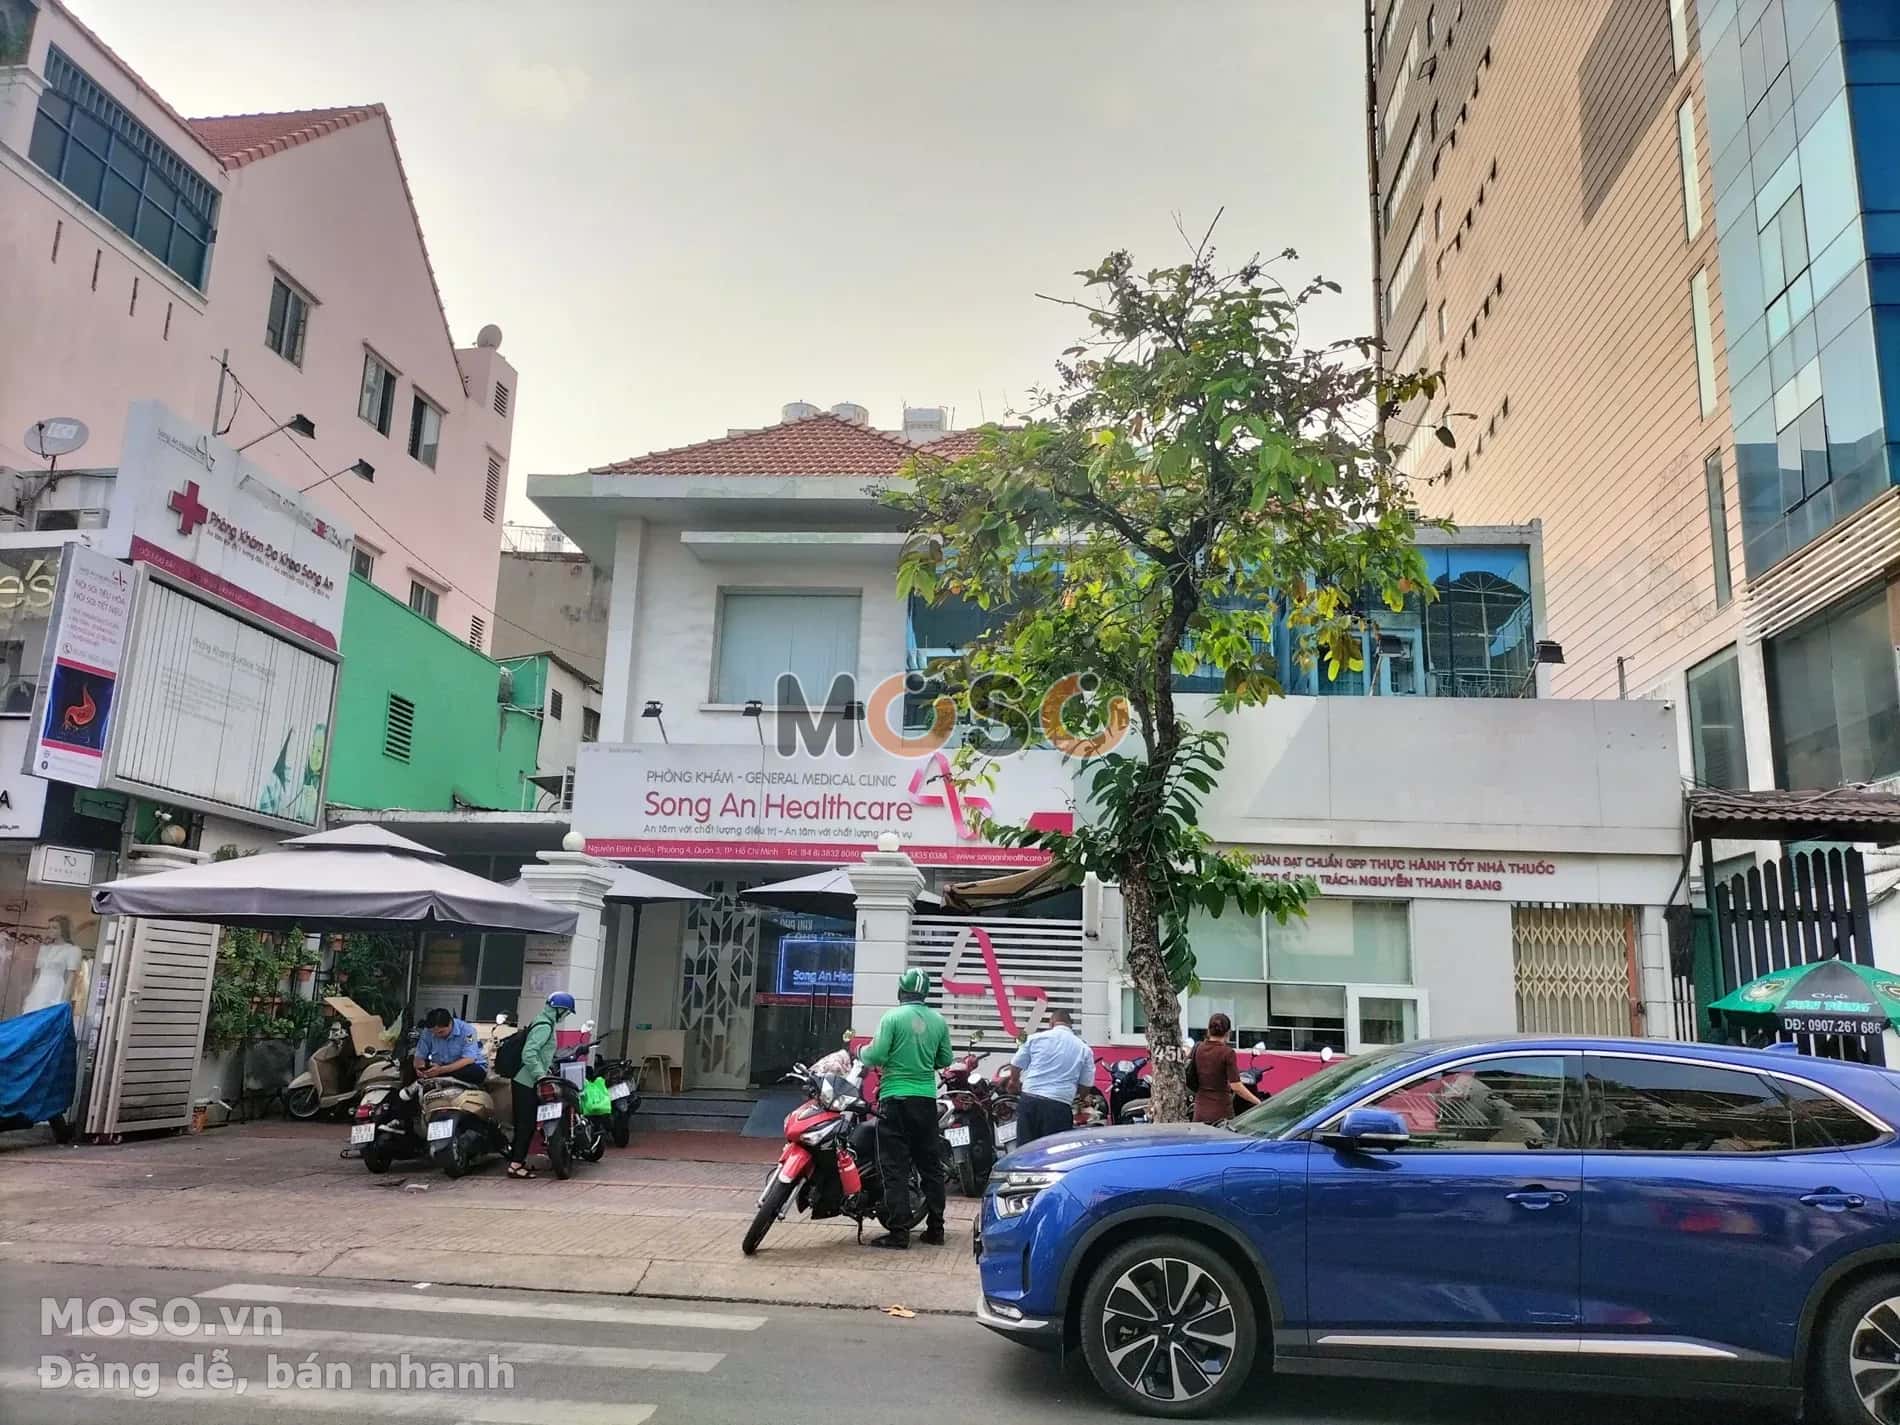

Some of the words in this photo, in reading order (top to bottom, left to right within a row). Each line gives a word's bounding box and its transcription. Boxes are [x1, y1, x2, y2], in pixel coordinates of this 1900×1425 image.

[209, 511, 237, 541] Phòng
[280, 552, 301, 574] Khoa
[301, 564, 322, 588] Song
[646, 768, 692, 784] PHÒNG
[695, 768, 734, 785] KHÁM
[745, 771, 799, 786] GENERAL
[802, 773, 856, 787] MEDICAL
[858, 774, 897, 788] CLINIC
[644, 791, 712, 824] Song
[719, 791, 756, 819] An
[765, 793, 913, 823] Healthcare
[643, 824, 657, 834] An
[658, 824, 677, 834] tâm
[784, 826, 797, 837] An
[799, 827, 816, 838] tâm
[760, 847, 779, 857] Minh
[1283, 855, 1303, 869] ĐẠT
[1305, 852, 1343, 869] CHUẨN
[1345, 858, 1367, 870] GPP
[1369, 857, 1406, 873] THỰC
[1408, 856, 1446, 873] HÀNH
[1449, 856, 1475, 873] TỐT
[1477, 858, 1506, 874] NHÀ
[1508, 859, 1556, 875] THUỐC
[1320, 872, 1358, 887] TRÁCH:
[1359, 873, 1414, 888] NGUYỄN
[1416, 876, 1462, 890] THANH
[1464, 878, 1502, 892] SANG
[793, 969, 817, 983] Song
[818, 970, 833, 981] An
[1807, 1018, 1858, 1034] 0907.261
[1860, 1021, 1882, 1035] 686
